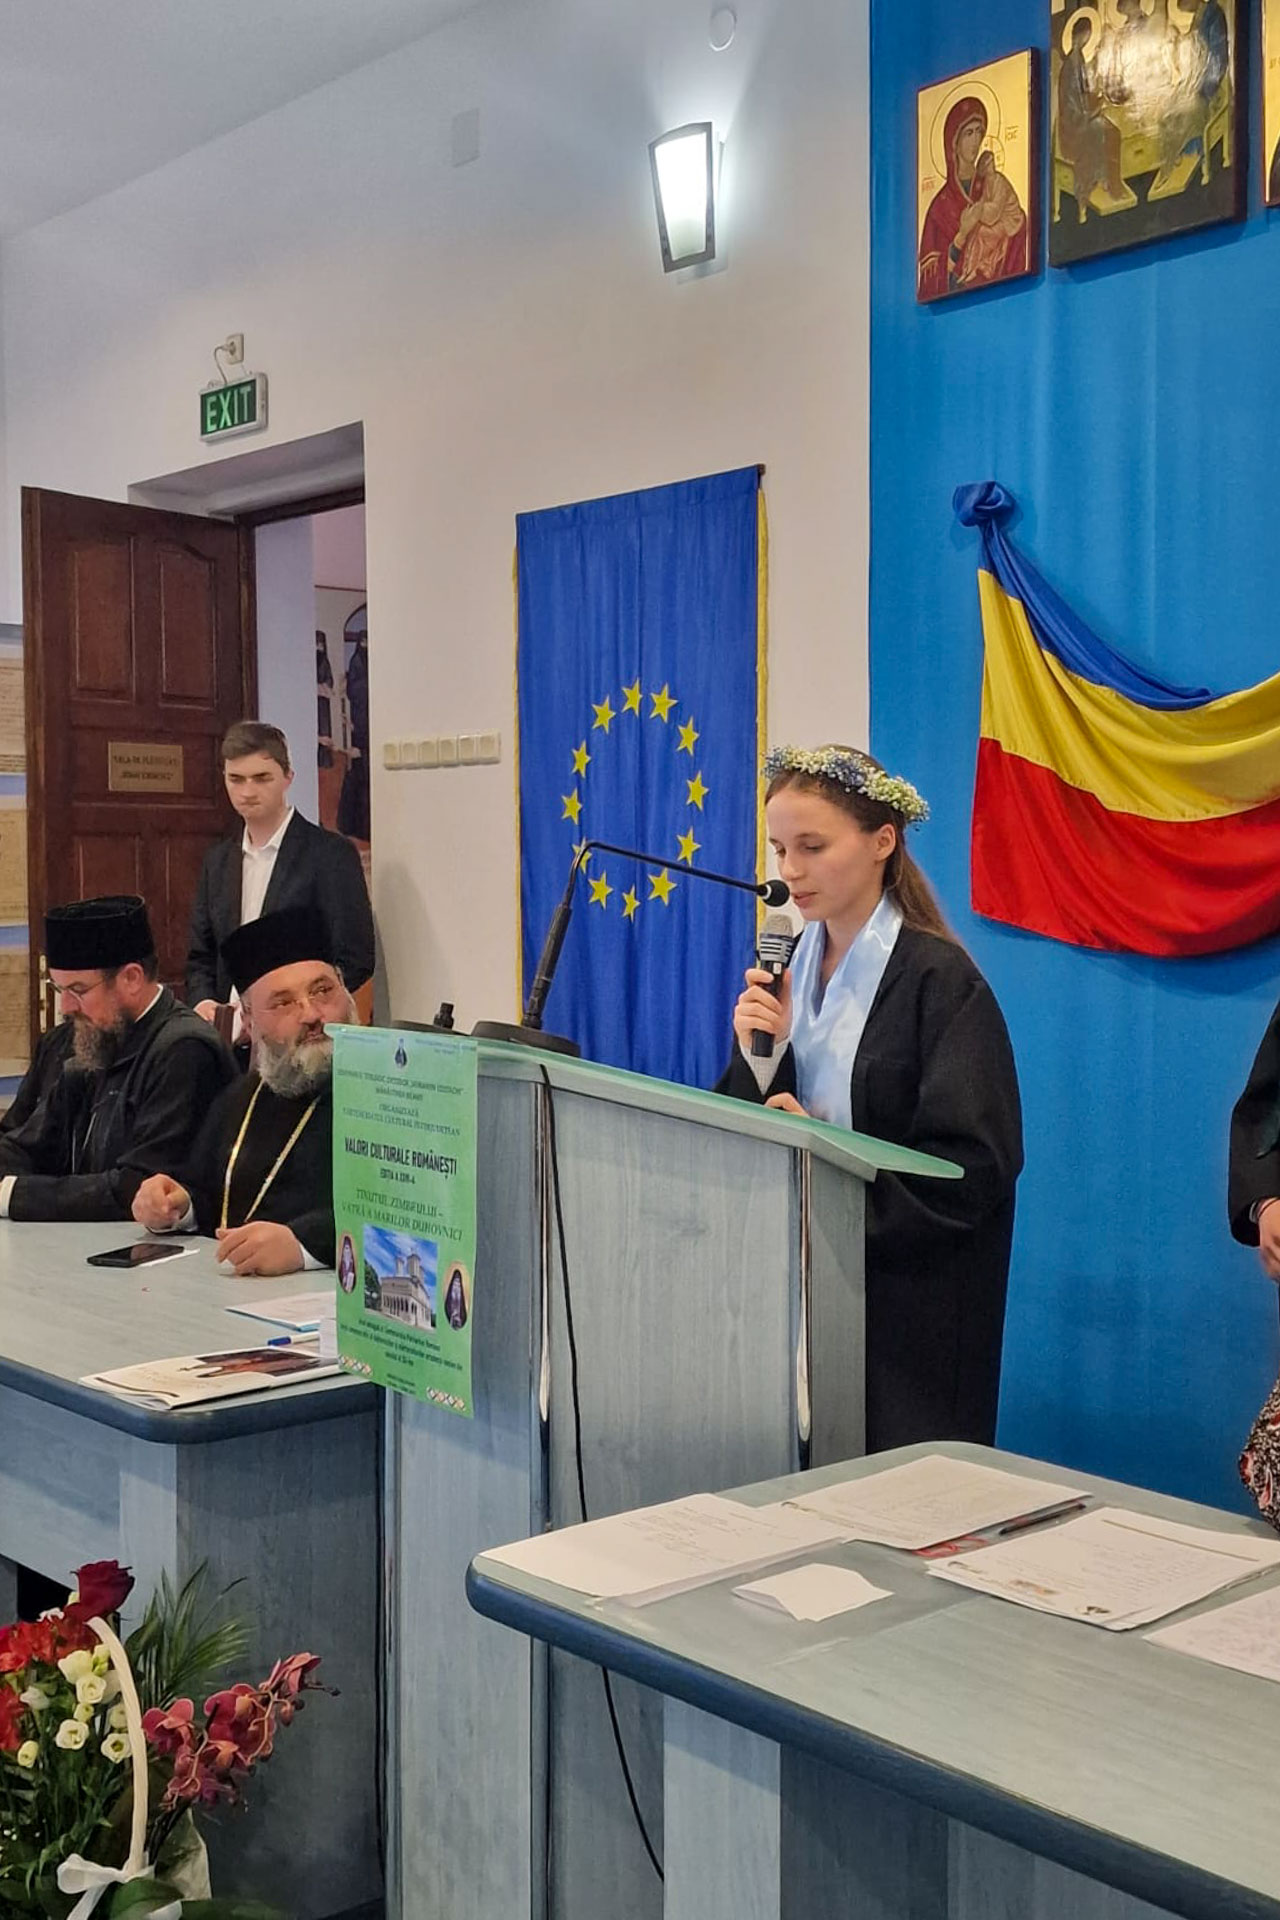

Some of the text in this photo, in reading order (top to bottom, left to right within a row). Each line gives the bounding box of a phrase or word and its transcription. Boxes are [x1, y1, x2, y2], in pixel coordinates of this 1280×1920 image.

[206, 384, 252, 432] EXIT
[344, 1137, 457, 1179] VALORI CULTURALE ROMÂNEȘTI
[373, 1209, 411, 1229] MARILOR
[412, 1219, 463, 1241] DUHOVNICI
